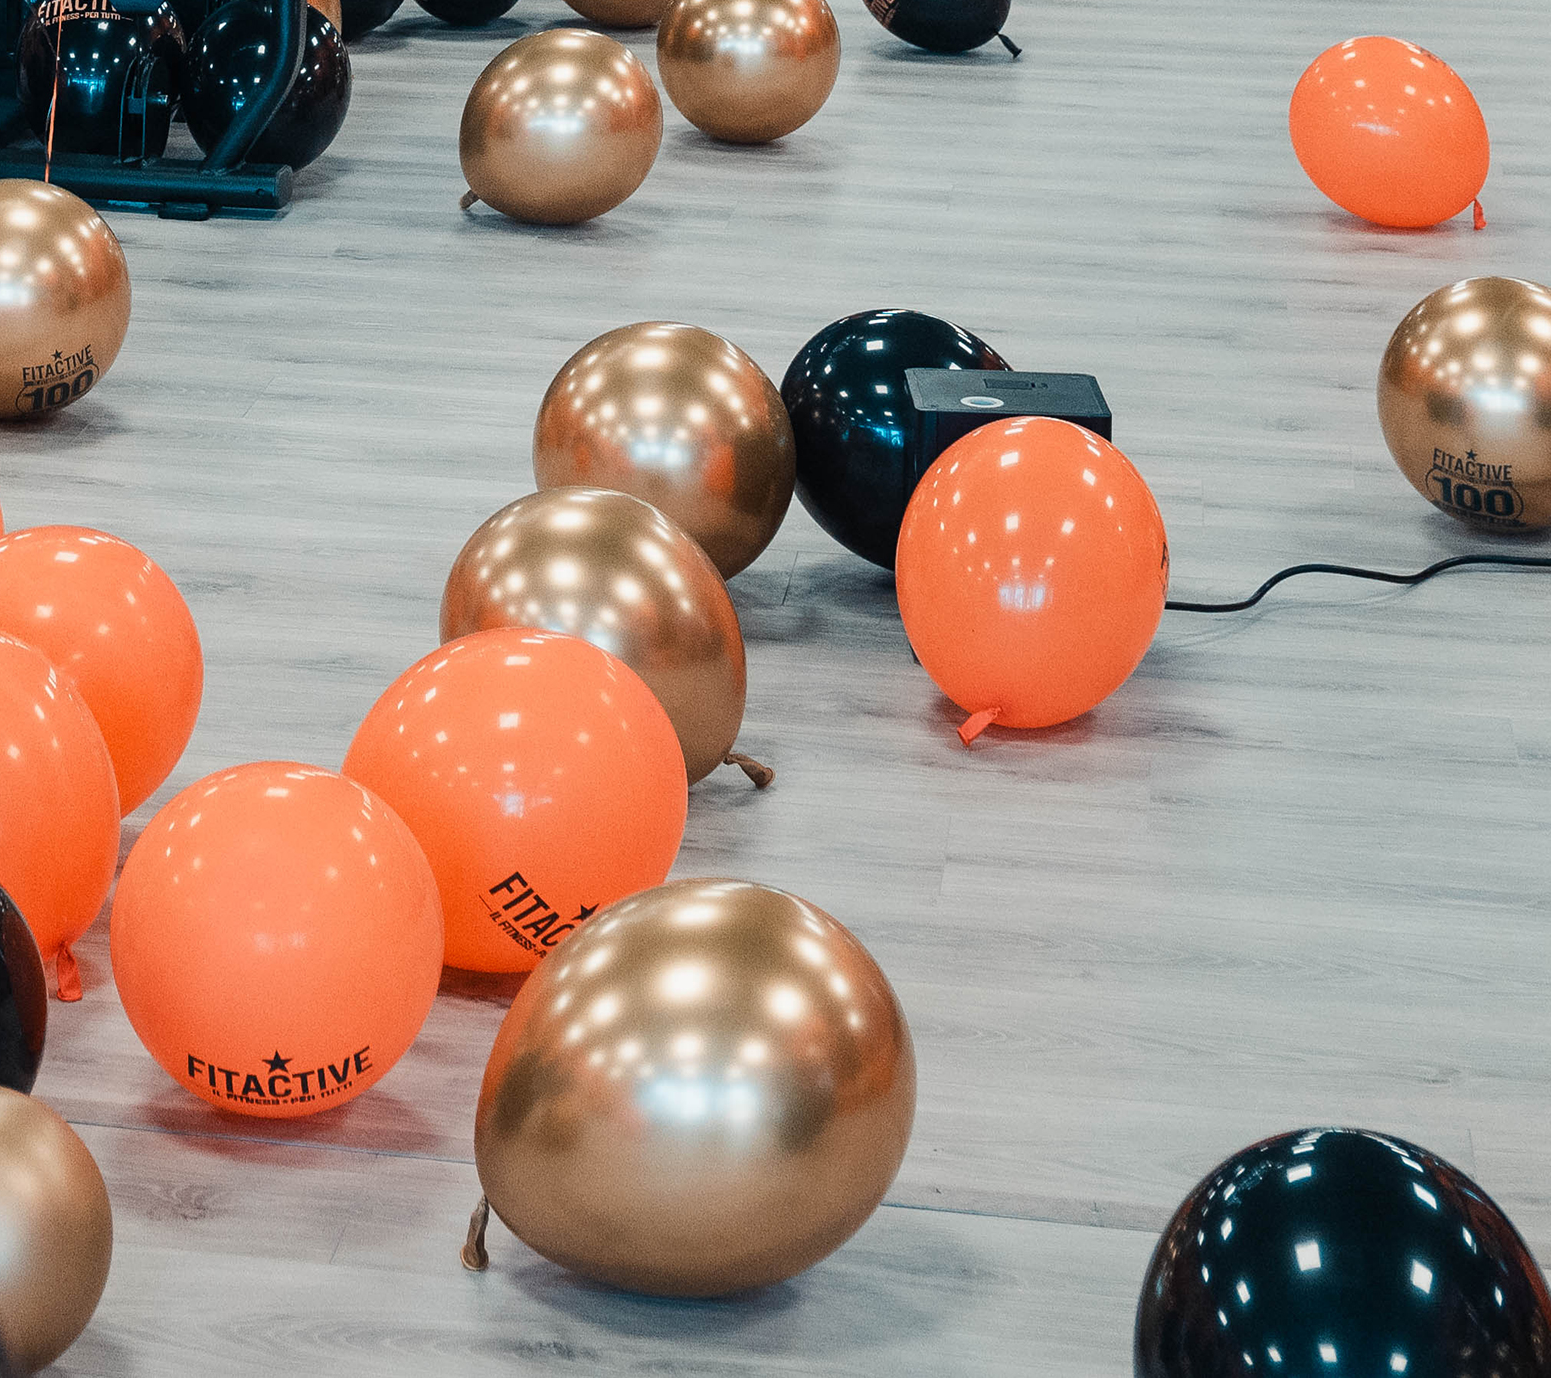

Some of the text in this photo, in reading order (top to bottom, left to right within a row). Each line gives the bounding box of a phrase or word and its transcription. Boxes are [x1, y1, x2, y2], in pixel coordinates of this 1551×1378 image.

[85, 11, 99, 19] PER
[22, 344, 93, 383] FITACTIVE
[1433, 447, 1513, 482] FITACTIVE
[1433, 474, 1515, 518] 100
[489, 871, 575, 947] FITAC
[489, 910, 538, 953] IL FITNESS
[187, 1045, 375, 1100] FITACTIVE
